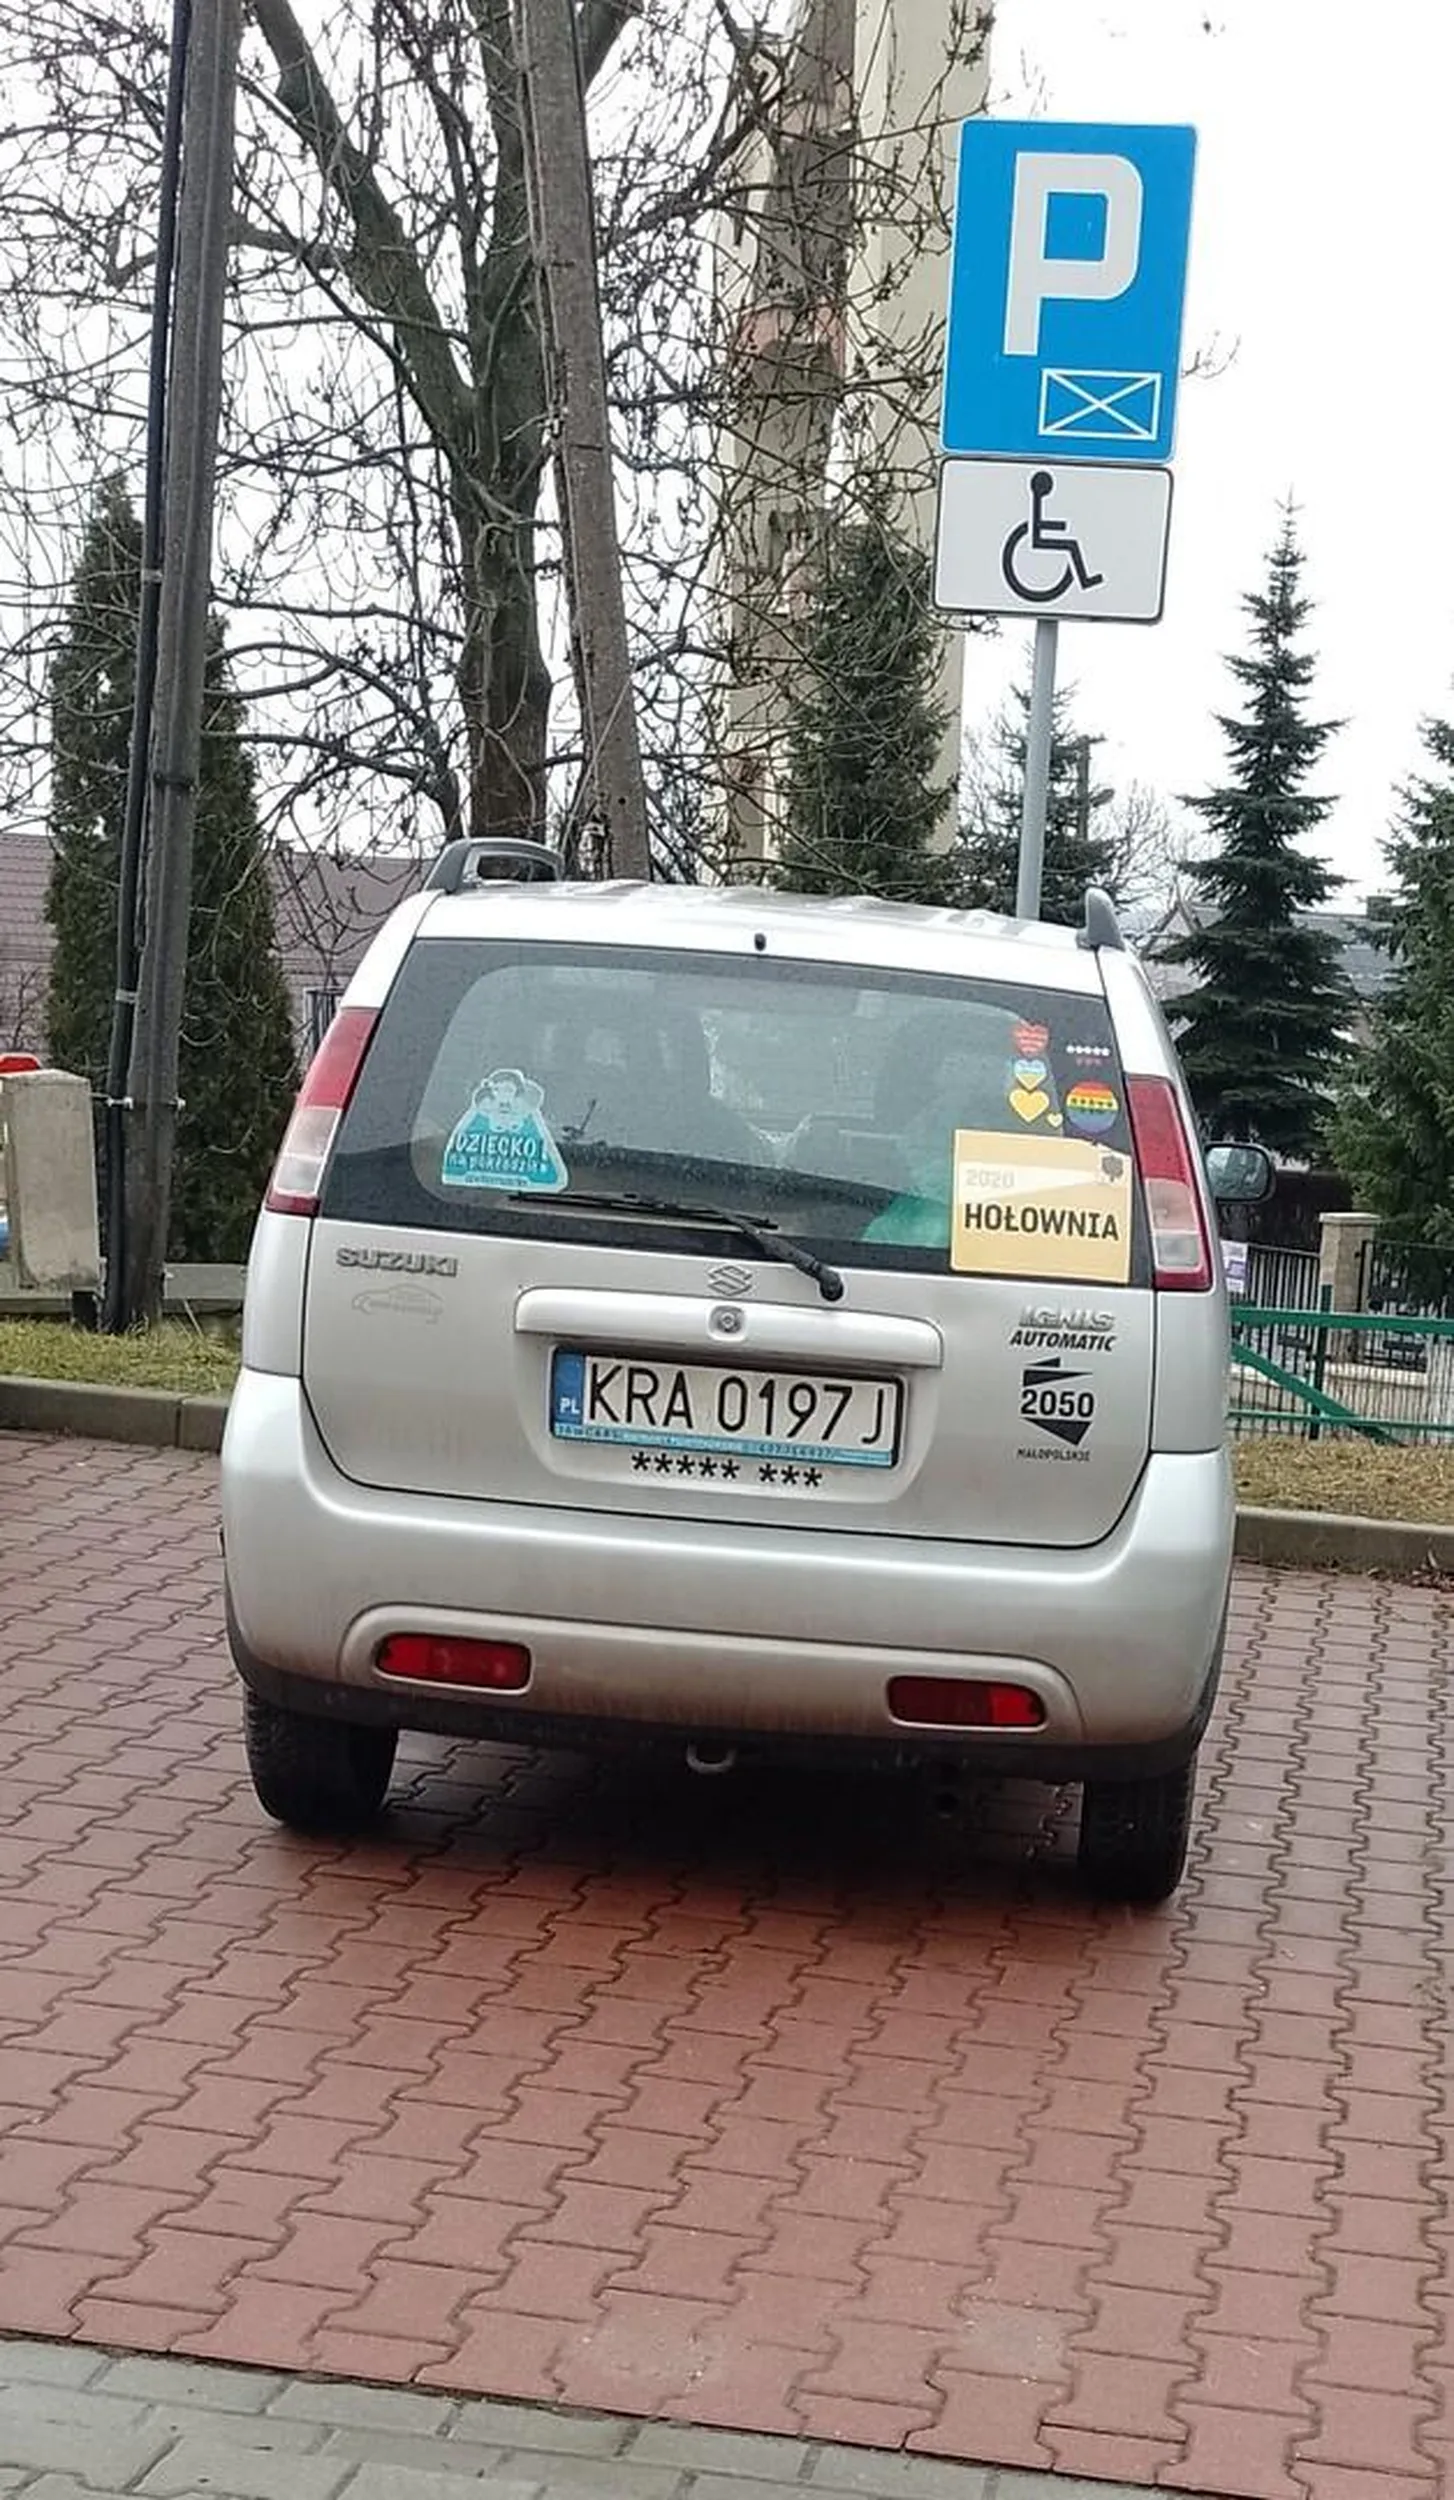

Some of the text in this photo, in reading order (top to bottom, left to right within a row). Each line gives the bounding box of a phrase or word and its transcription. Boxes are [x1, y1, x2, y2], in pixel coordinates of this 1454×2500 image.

[1003, 151, 1143, 356] P
[455, 1132, 537, 1158] DZIECKO
[965, 1168, 1015, 1189] 2020
[964, 1202, 1120, 1241] HOŁOWNIA
[335, 1247, 459, 1278] SUZUKI
[1018, 1307, 1116, 1332] IGNIS
[1010, 1330, 1117, 1352] AUTOMATIC
[559, 1397, 580, 1416] PL
[587, 1362, 694, 1430] KRA
[1020, 1388, 1095, 1418] 2050
